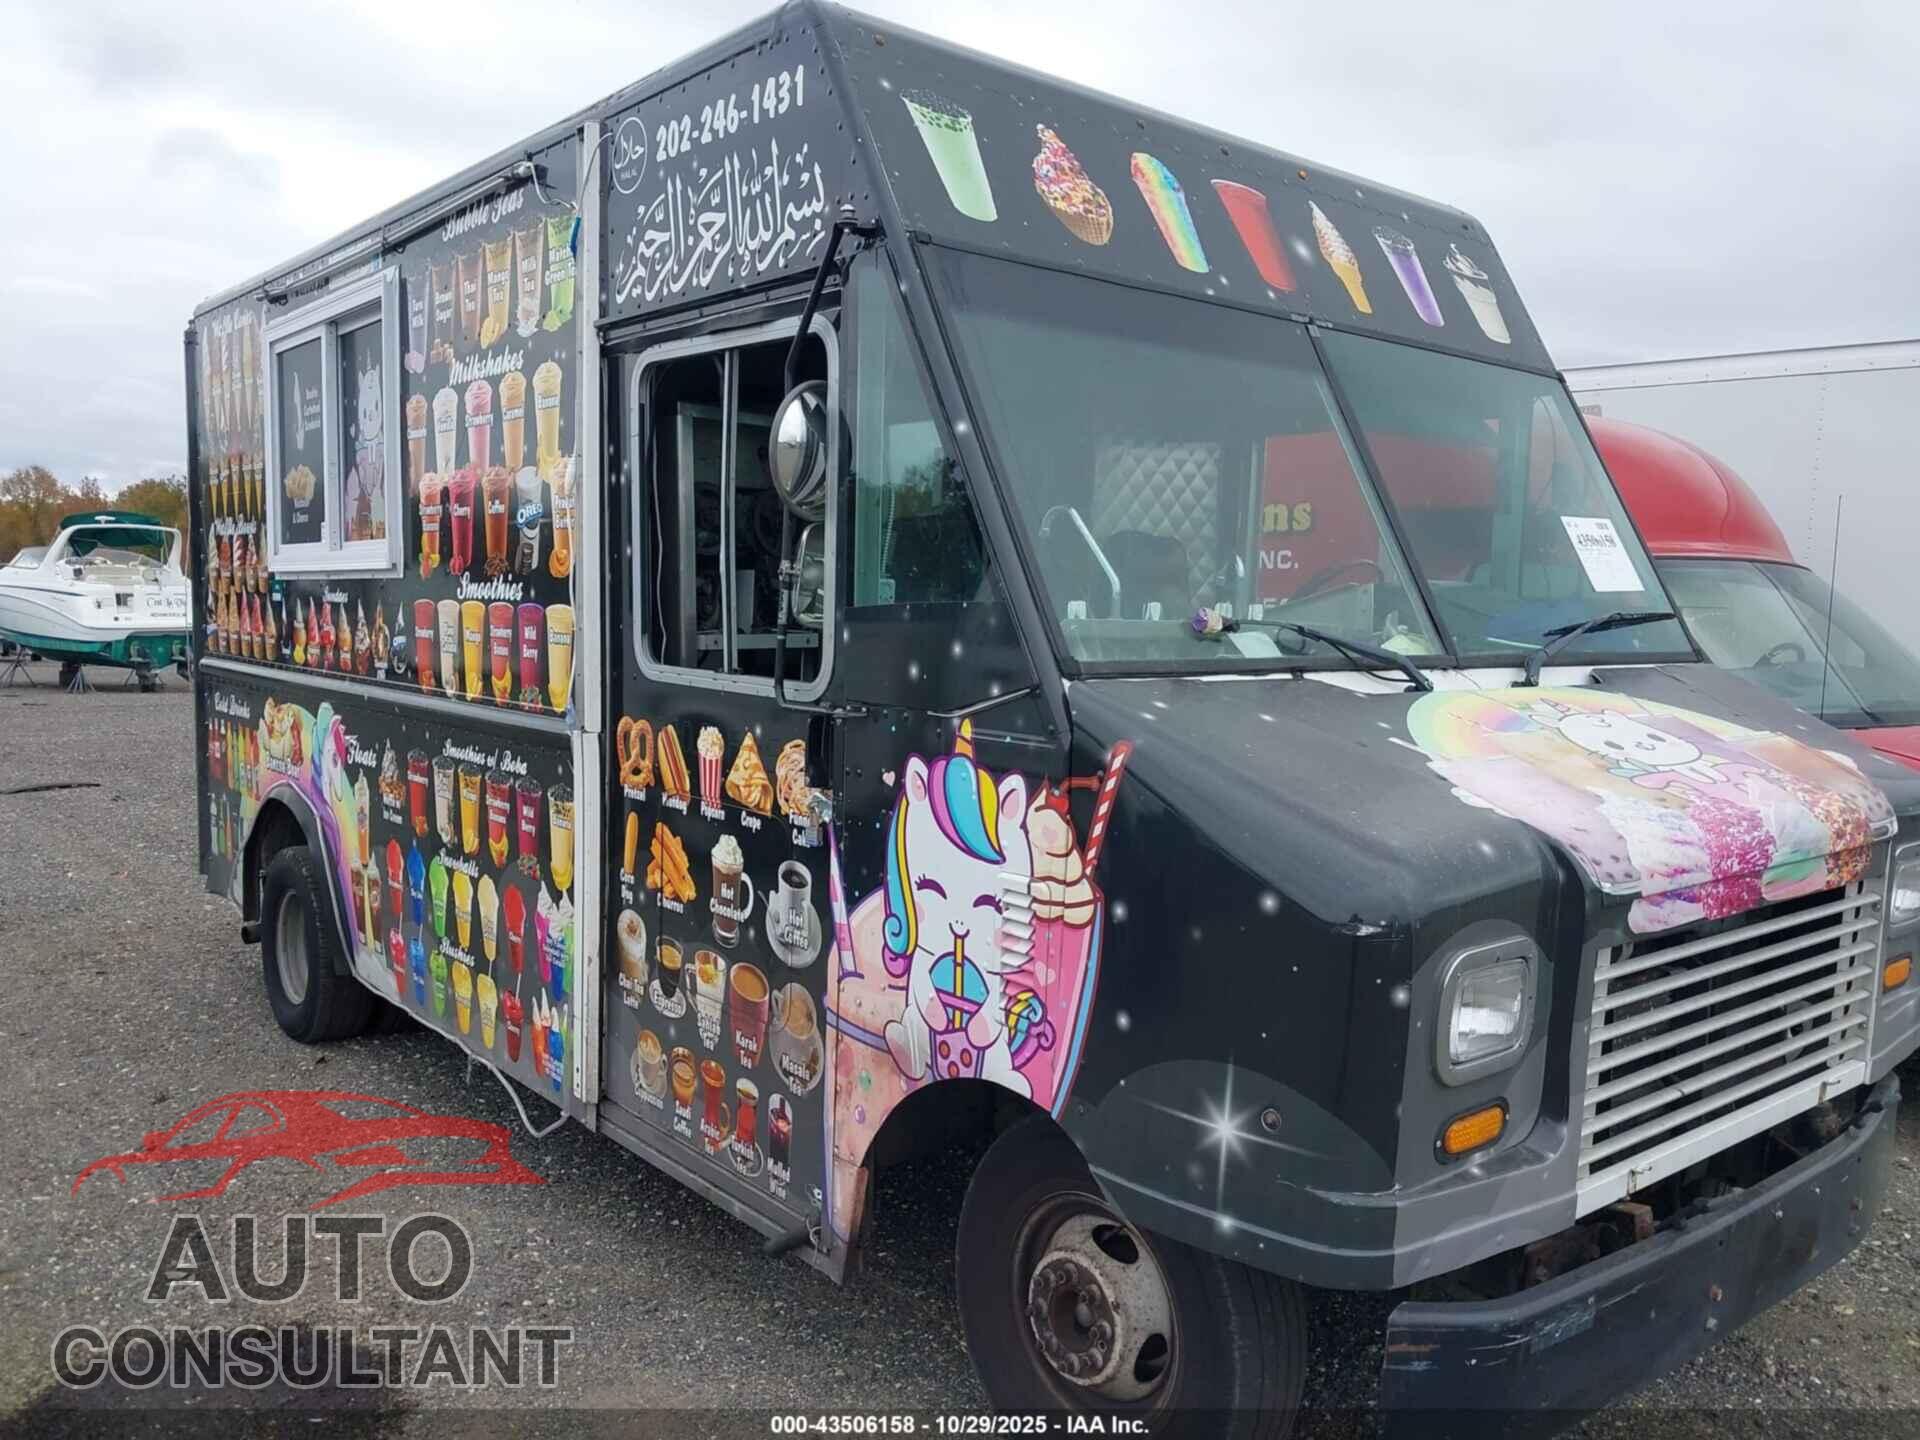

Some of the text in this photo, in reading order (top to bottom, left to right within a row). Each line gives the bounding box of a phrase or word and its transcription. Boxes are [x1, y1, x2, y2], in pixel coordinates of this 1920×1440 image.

[656, 64, 805, 163] 202-246-1431
[450, 346, 525, 387] Milkshakes
[516, 503, 543, 525] OREO
[1263, 501, 1313, 532] ns
[1258, 549, 1299, 570] NC.
[457, 571, 524, 601] Smoothies
[345, 735, 378, 768] Floats
[443, 738, 486, 766] Smoothies
[500, 750, 528, 776] Boba
[623, 785, 646, 802] Pretzel
[740, 810, 762, 834] Crepe
[720, 883, 735, 900] Hot
[709, 897, 749, 923] Chocolate
[788, 909, 804, 928] Hot
[784, 926, 809, 950] Coffee
[439, 936, 476, 968] Slushies
[735, 1030, 758, 1051] Karak
[739, 1050, 753, 1069] Tea
[781, 1054, 811, 1081] Masala
[787, 1077, 802, 1097] Tea
[767, 1158, 791, 1185] Mulled
